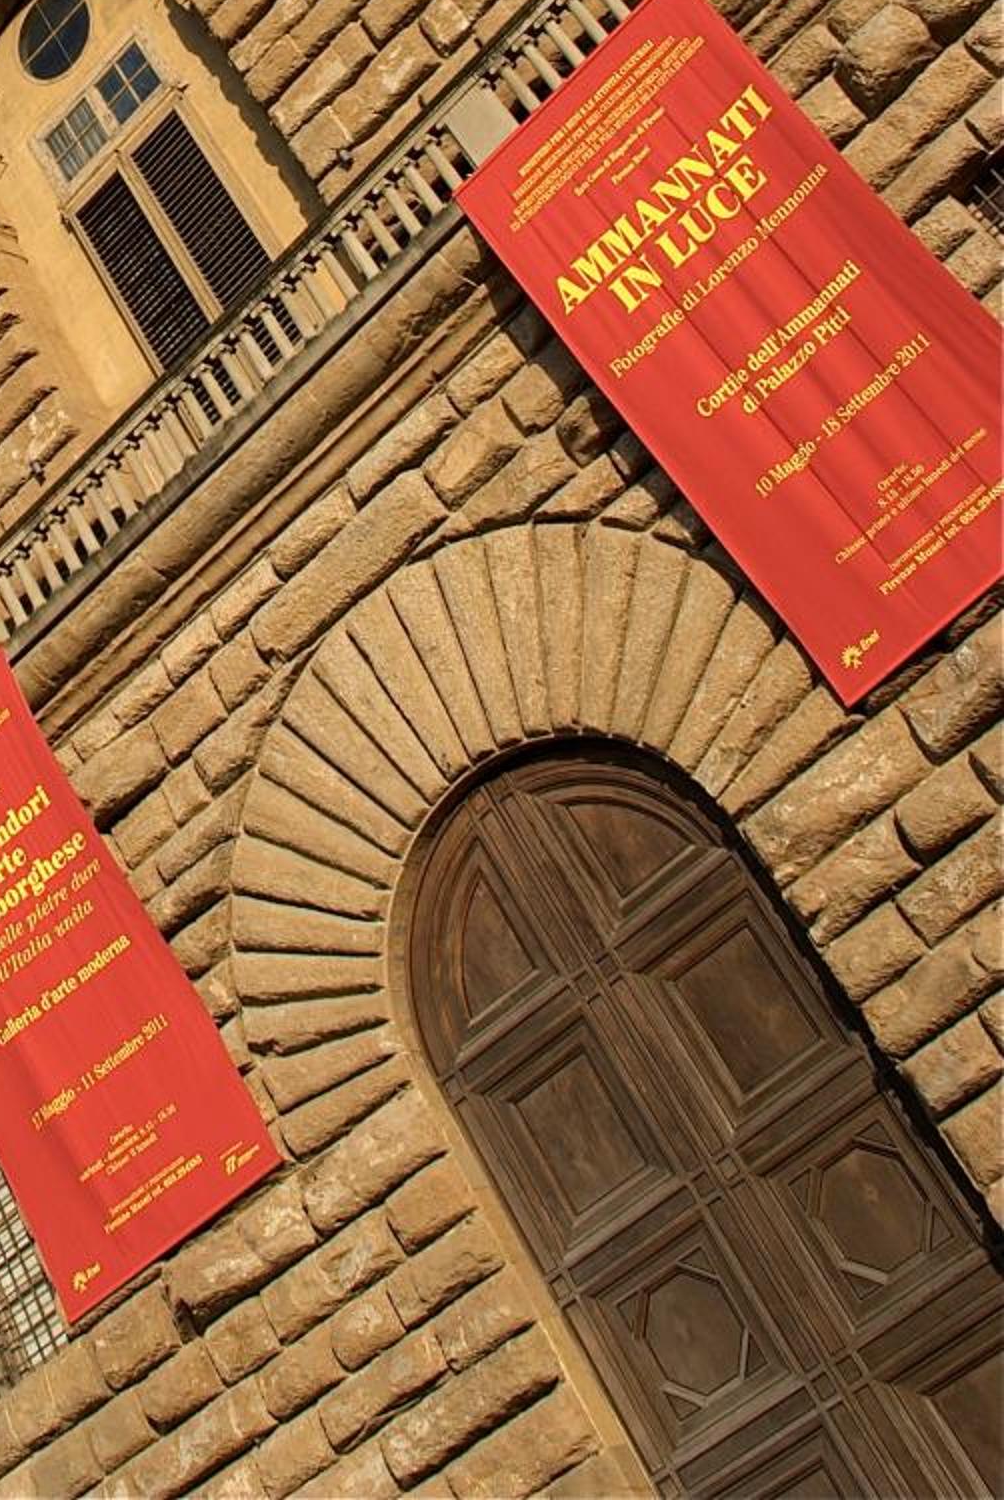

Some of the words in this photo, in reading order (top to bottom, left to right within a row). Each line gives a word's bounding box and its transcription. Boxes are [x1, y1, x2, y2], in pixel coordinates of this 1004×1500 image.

[557, 86, 771, 314] AMMANNATI
[608, 254, 662, 313] IN
[655, 155, 767, 268] LUCE
[610, 309, 685, 378] Fotografie
[682, 289, 700, 311] di
[695, 237, 759, 296] Lorenzo
[755, 163, 827, 240] Mennonna
[697, 369, 749, 417] Cortile
[747, 259, 861, 372] dell'Ammannati
[743, 395, 760, 413] di
[754, 341, 816, 398] Palazzo
[812, 306, 851, 345] Pitti
[755, 476, 773, 497] 10
[768, 441, 816, 484] Maggio
[821, 417, 841, 437] 18
[836, 363, 901, 423] Settembre
[895, 333, 930, 367] 2011
[26, 887, 67, 932] pietre
[71, 859, 100, 892] dure
[54, 900, 94, 937] unita
[40, 977, 77, 1011] d'arte
[77, 935, 131, 983] moderna
[81, 1072, 95, 1090] 11
[93, 1034, 145, 1079] Settembre
[141, 1014, 168, 1041] 2011
